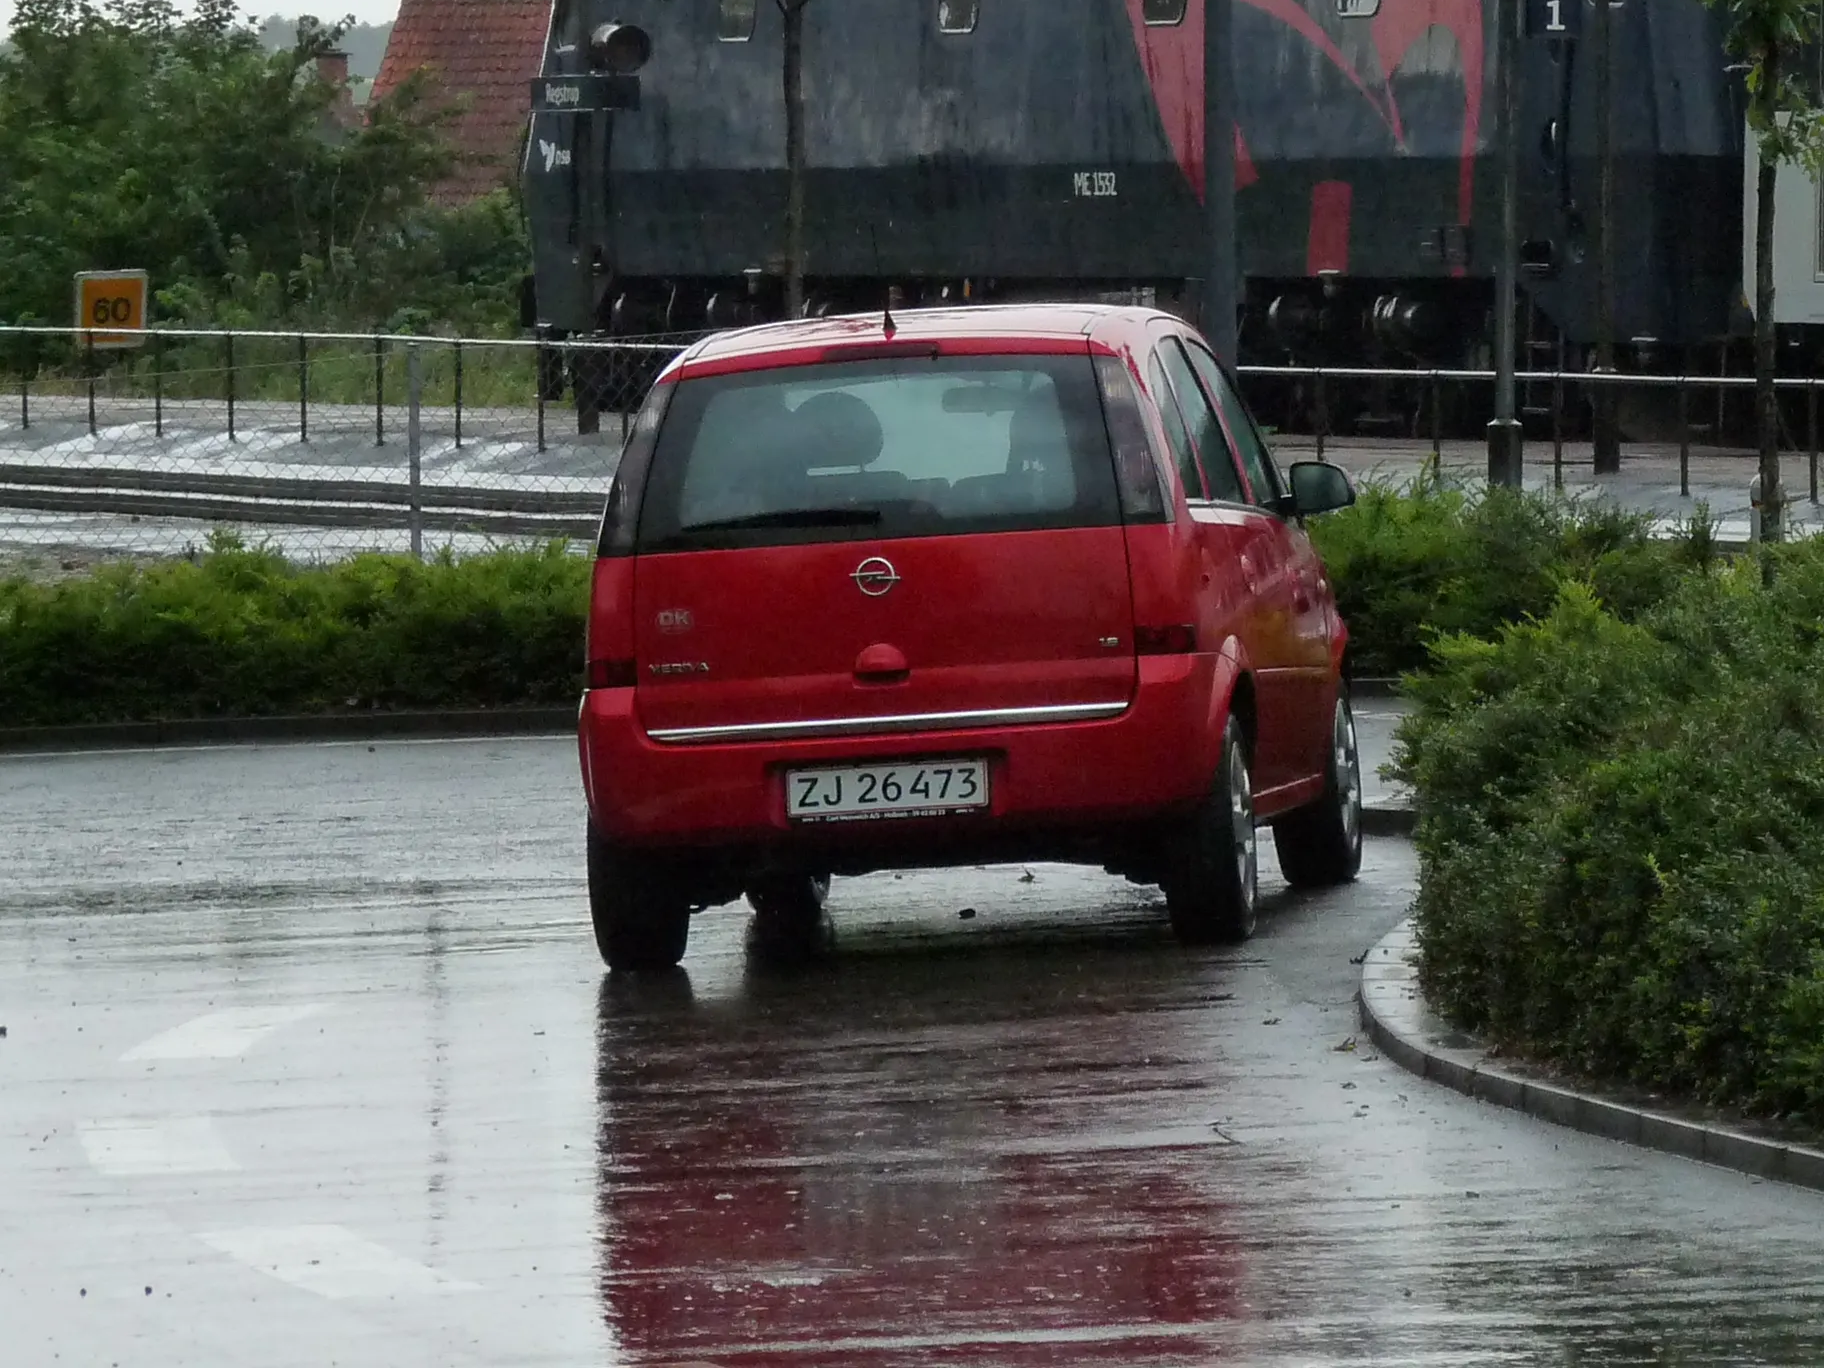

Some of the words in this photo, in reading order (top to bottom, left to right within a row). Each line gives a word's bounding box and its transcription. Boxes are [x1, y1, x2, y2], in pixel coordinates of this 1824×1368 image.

[1546, 0, 1566, 31] 1
[545, 82, 580, 106] Regstrup
[555, 150, 571, 165] DSB
[1074, 172, 1091, 197] ME
[1093, 172, 1118, 196] 1532
[93, 297, 131, 324] 60
[659, 611, 689, 626] DK
[797, 775, 842, 808] ZJ
